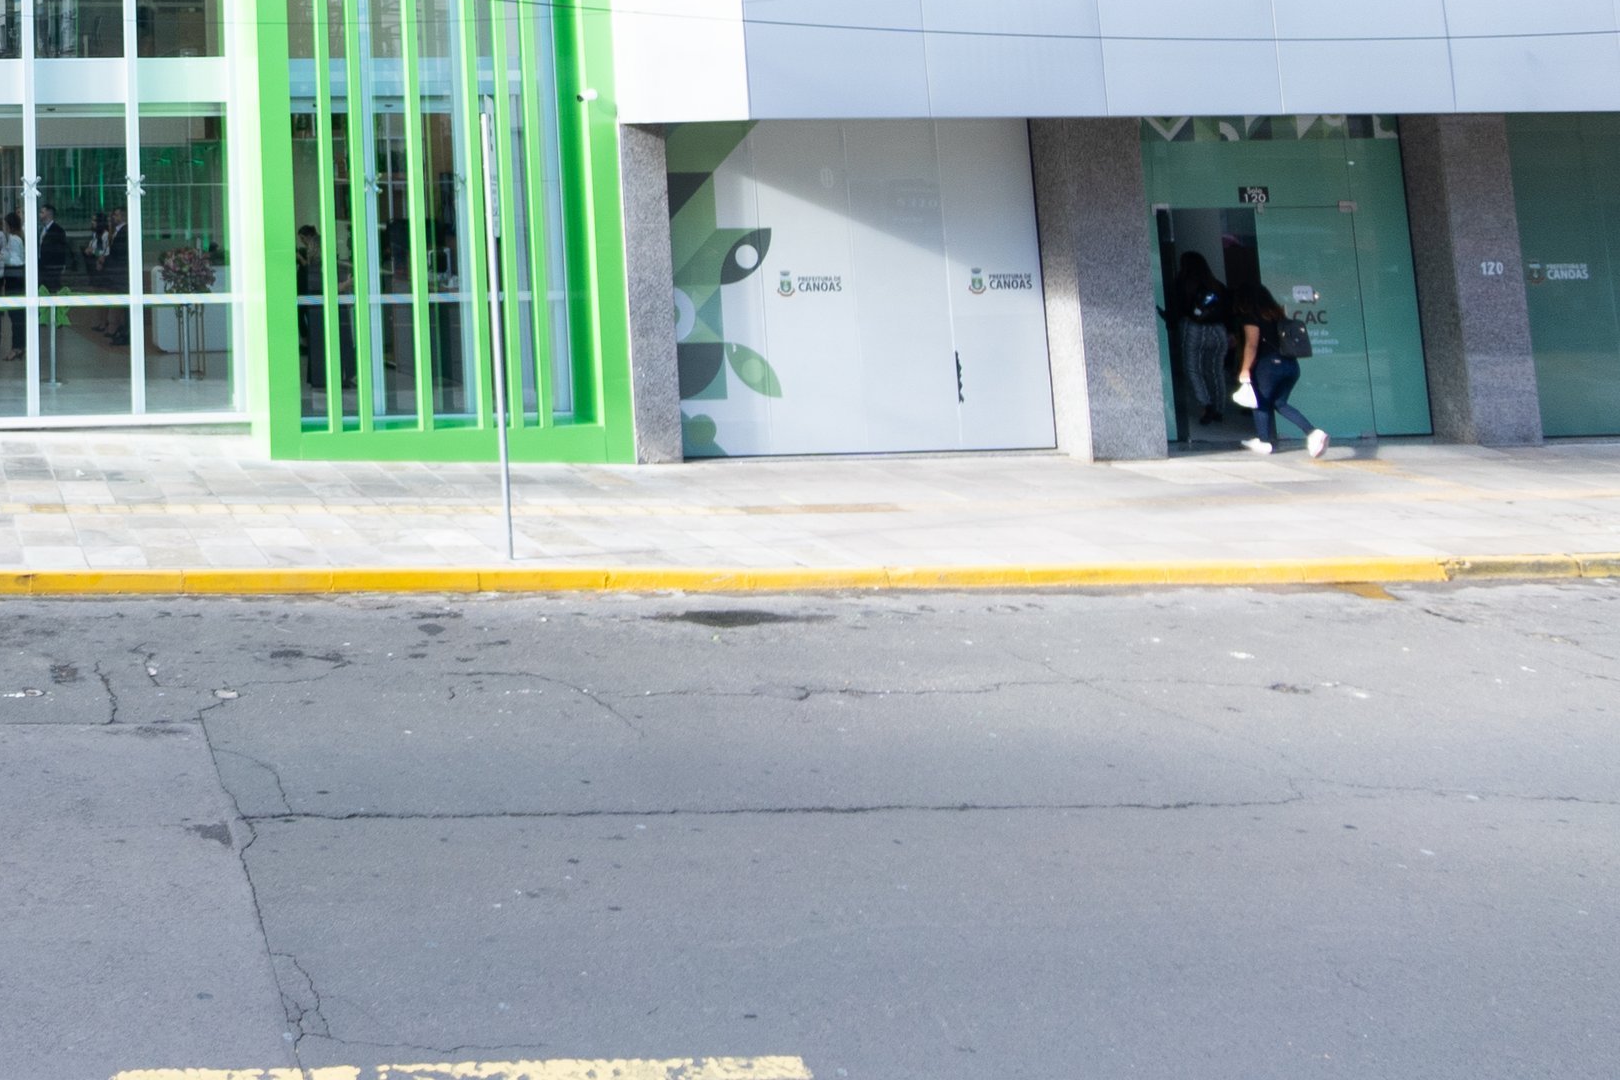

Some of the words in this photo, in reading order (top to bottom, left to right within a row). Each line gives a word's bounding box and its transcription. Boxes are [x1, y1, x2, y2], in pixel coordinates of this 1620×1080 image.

[1244, 193, 1267, 203] 120
[1480, 261, 1504, 276] 120
[1547, 269, 1589, 279] CANOAS
[798, 281, 842, 292] CANOAS
[989, 279, 1033, 290] CANOAS
